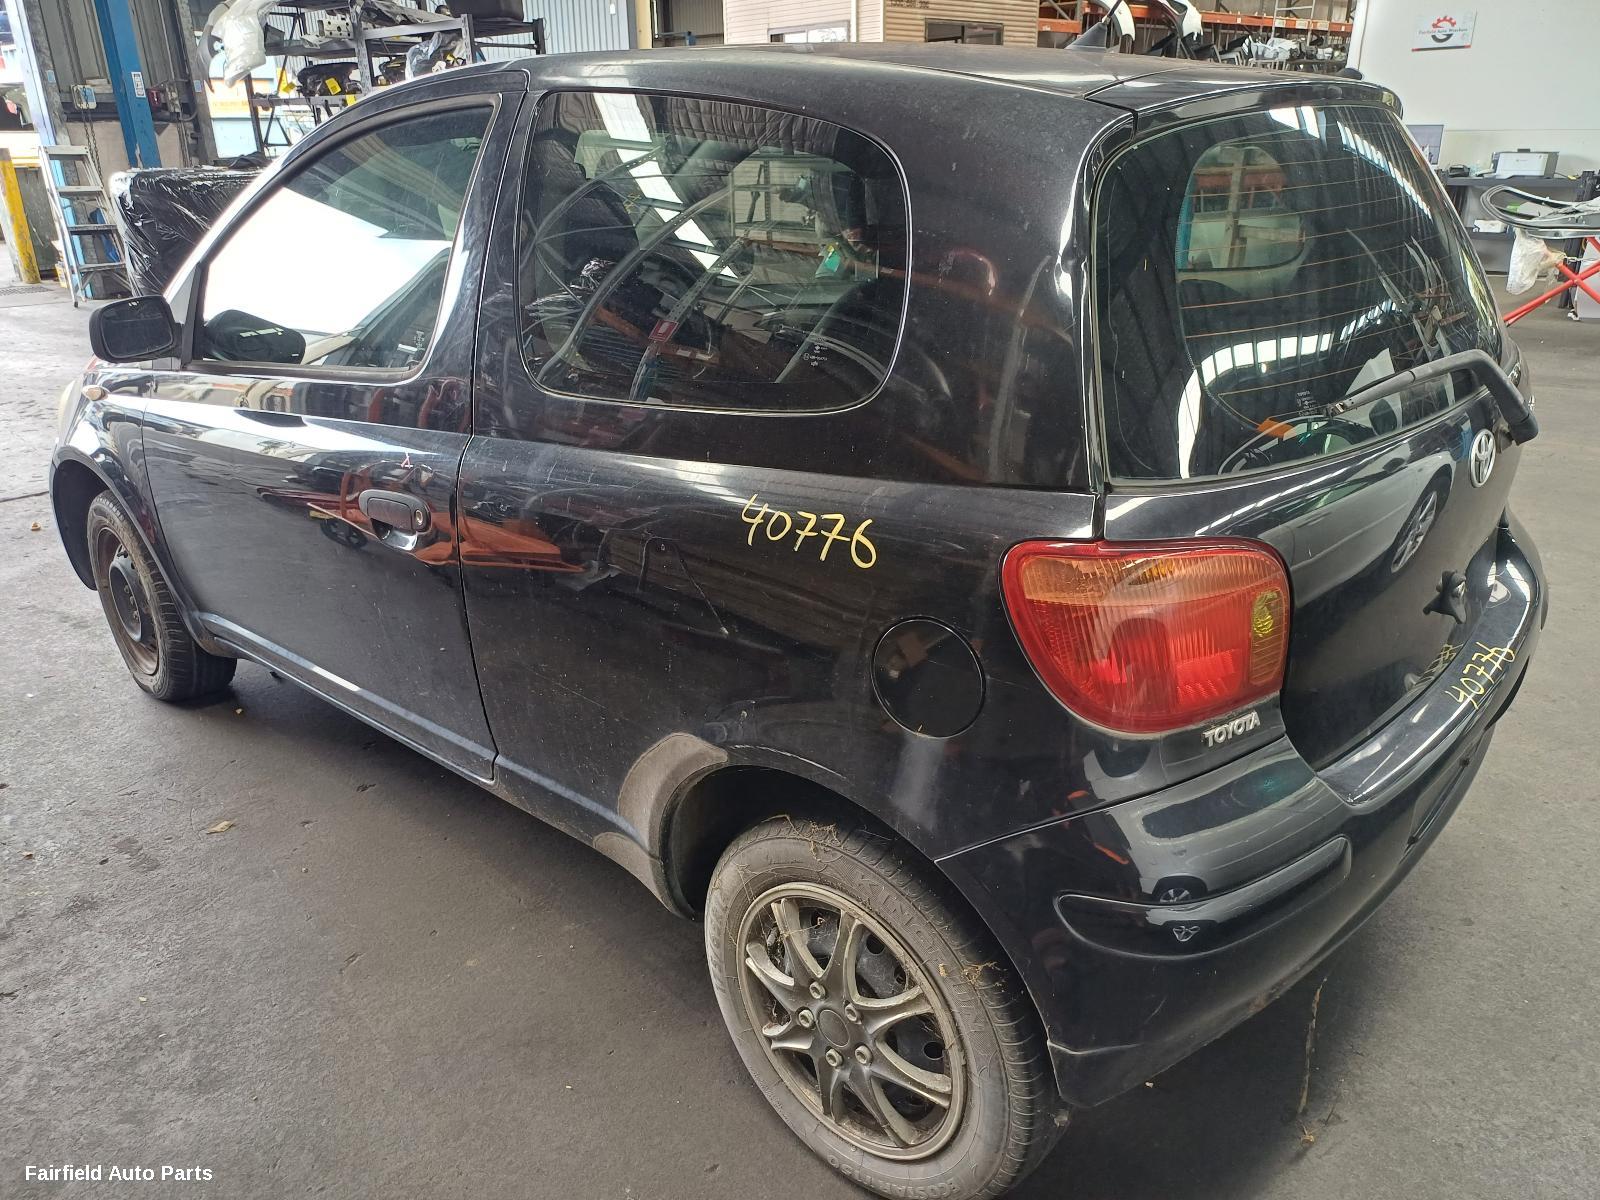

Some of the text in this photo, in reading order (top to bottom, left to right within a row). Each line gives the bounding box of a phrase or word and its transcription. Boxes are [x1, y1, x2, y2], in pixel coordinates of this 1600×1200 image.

[741, 493, 877, 569] 40776
[1444, 641, 1516, 710] 40776
[1202, 710, 1261, 748] TOYOTA
